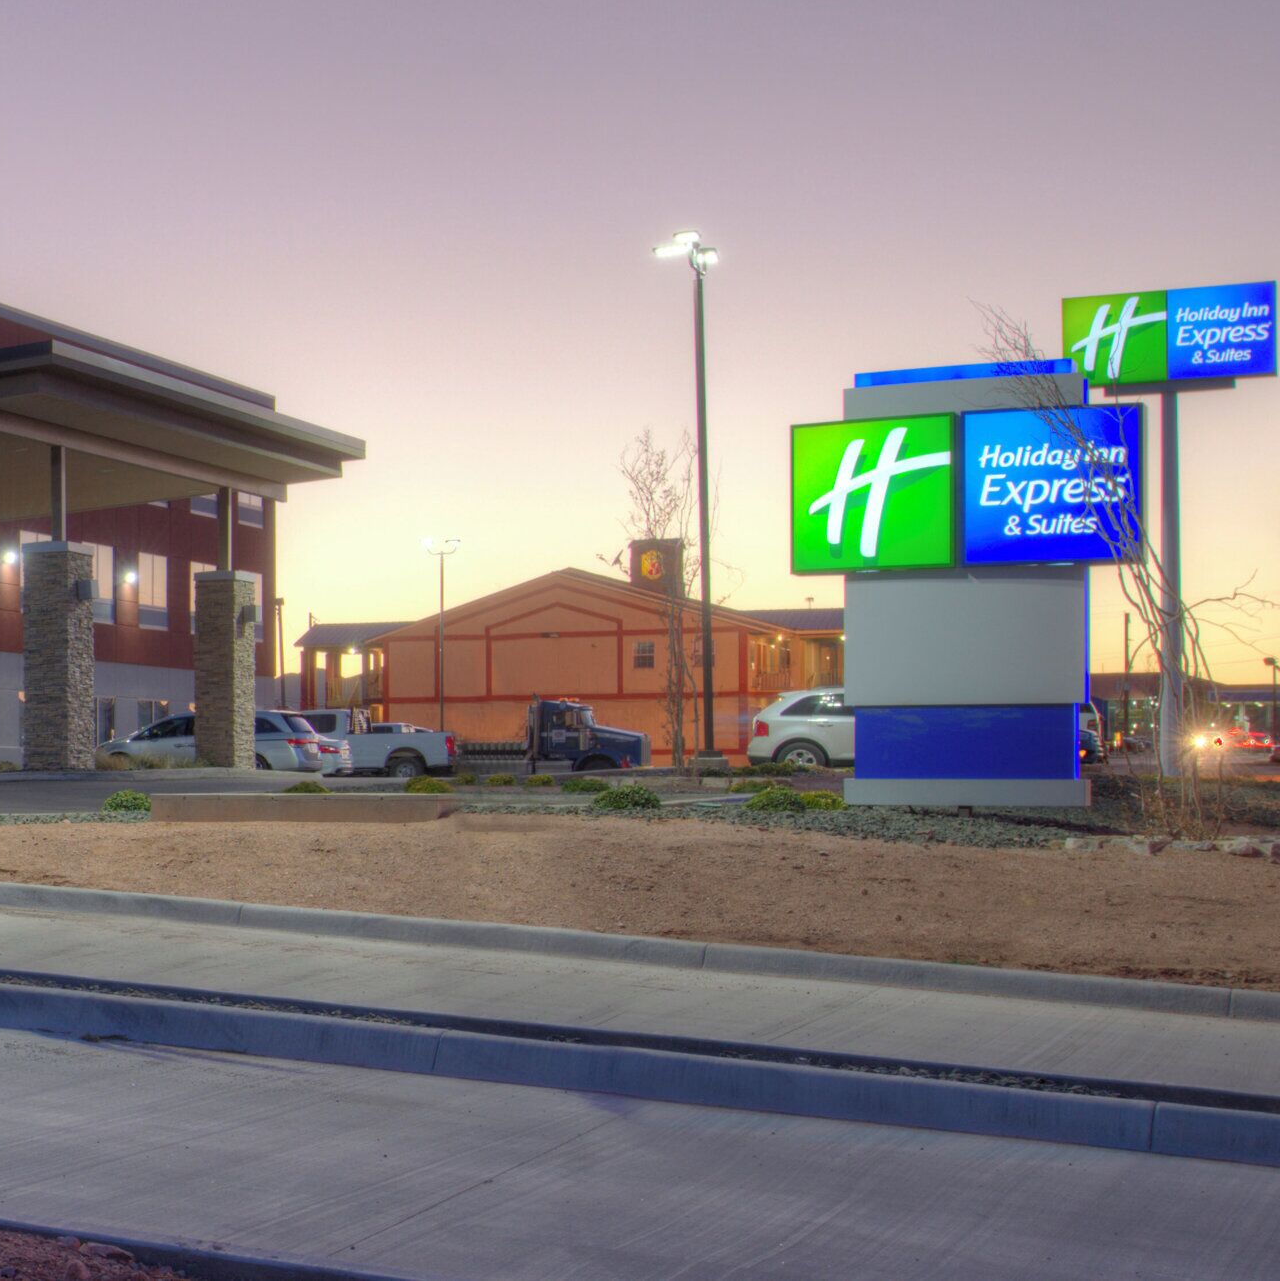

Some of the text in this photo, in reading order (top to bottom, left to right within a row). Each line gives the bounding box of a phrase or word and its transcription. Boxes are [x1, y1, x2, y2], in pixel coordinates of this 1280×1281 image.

[1174, 301, 1270, 323] Holiday Inn
[1175, 323, 1271, 350] Express
[1191, 347, 1252, 365] & Suites
[978, 442, 1080, 470] Holiday
[979, 473, 1127, 514] Express
[1004, 513, 1098, 536] & Suites
